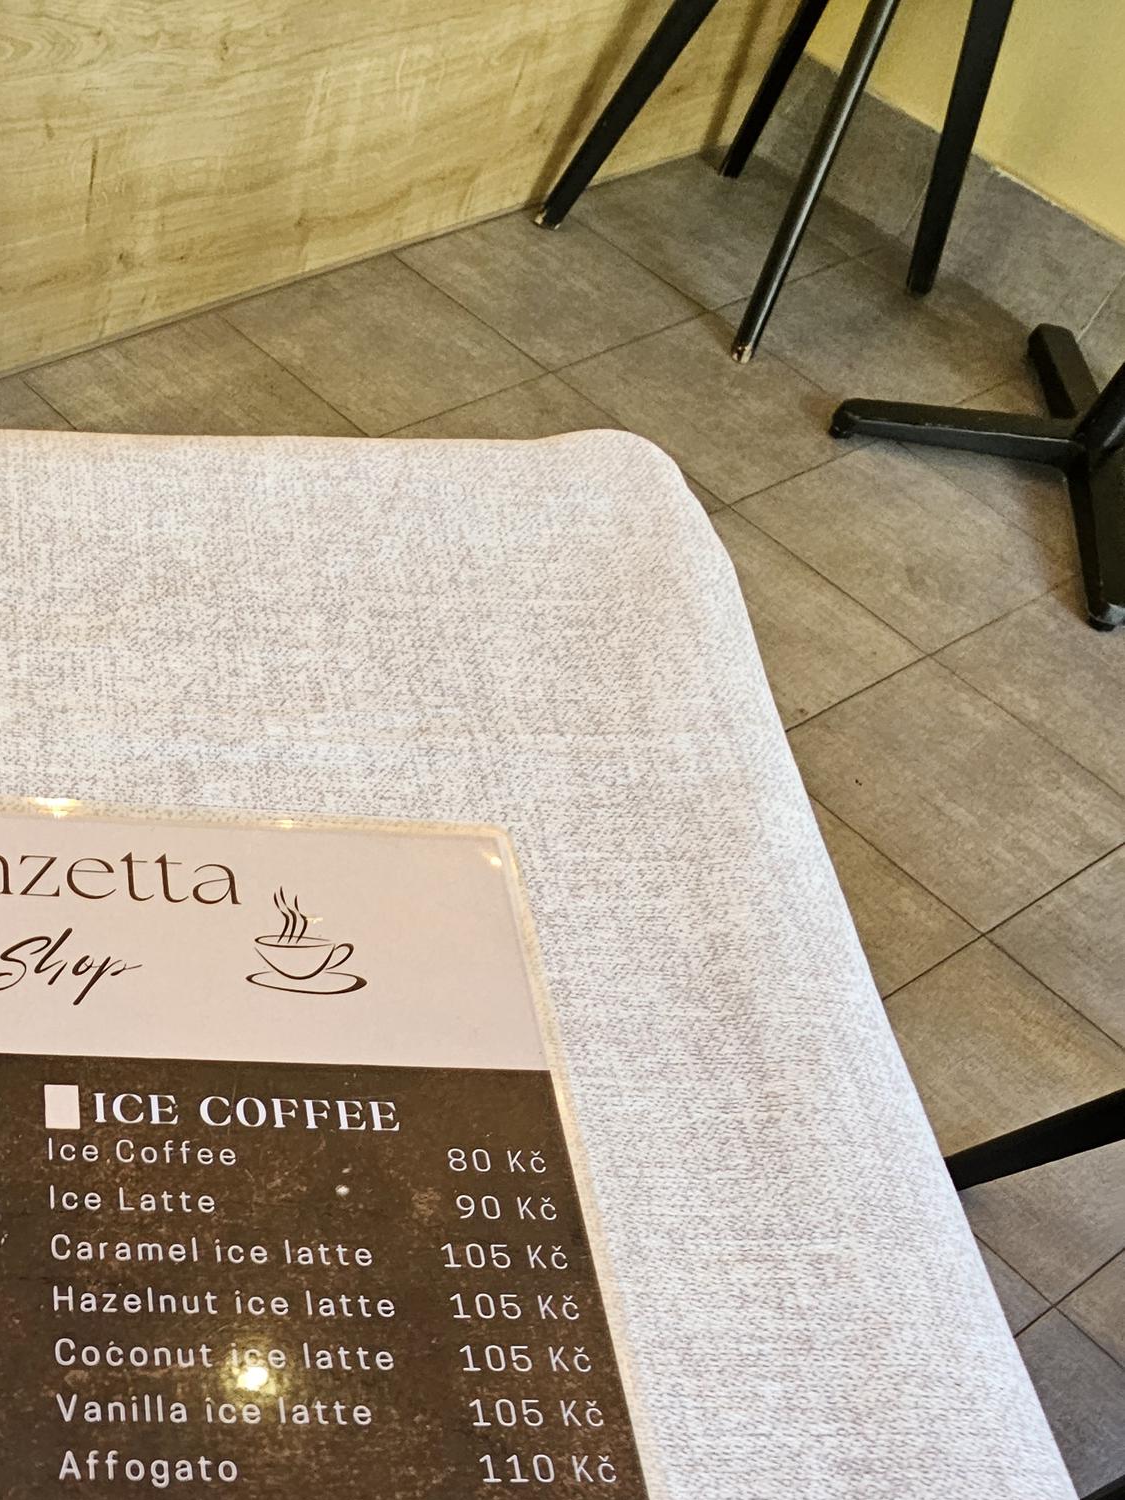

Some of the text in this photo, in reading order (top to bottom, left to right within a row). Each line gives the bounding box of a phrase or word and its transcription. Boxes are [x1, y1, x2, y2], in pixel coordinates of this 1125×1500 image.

[93, 1092, 400, 1132] ICE COFFEE
[48, 1137, 237, 1166] Ice Coffee
[447, 1148, 547, 1174] 80 Kč
[49, 1184, 215, 1214] Ice Latte
[455, 1194, 557, 1221] 90 Kč
[51, 1233, 373, 1267] Caramel ice latte
[440, 1242, 568, 1270] 105 Kč
[53, 1285, 395, 1318] Hazelnut ice latte
[449, 1293, 580, 1321] 105 Kč
[54, 1337, 394, 1371] Coconut ice latte
[459, 1344, 592, 1373] 105 Kč
[55, 1393, 372, 1426] Vanilla ice latte
[468, 1398, 604, 1427] 105 Kč
[58, 1449, 238, 1489] Affogato
[479, 1454, 617, 1484] 110 Kč
